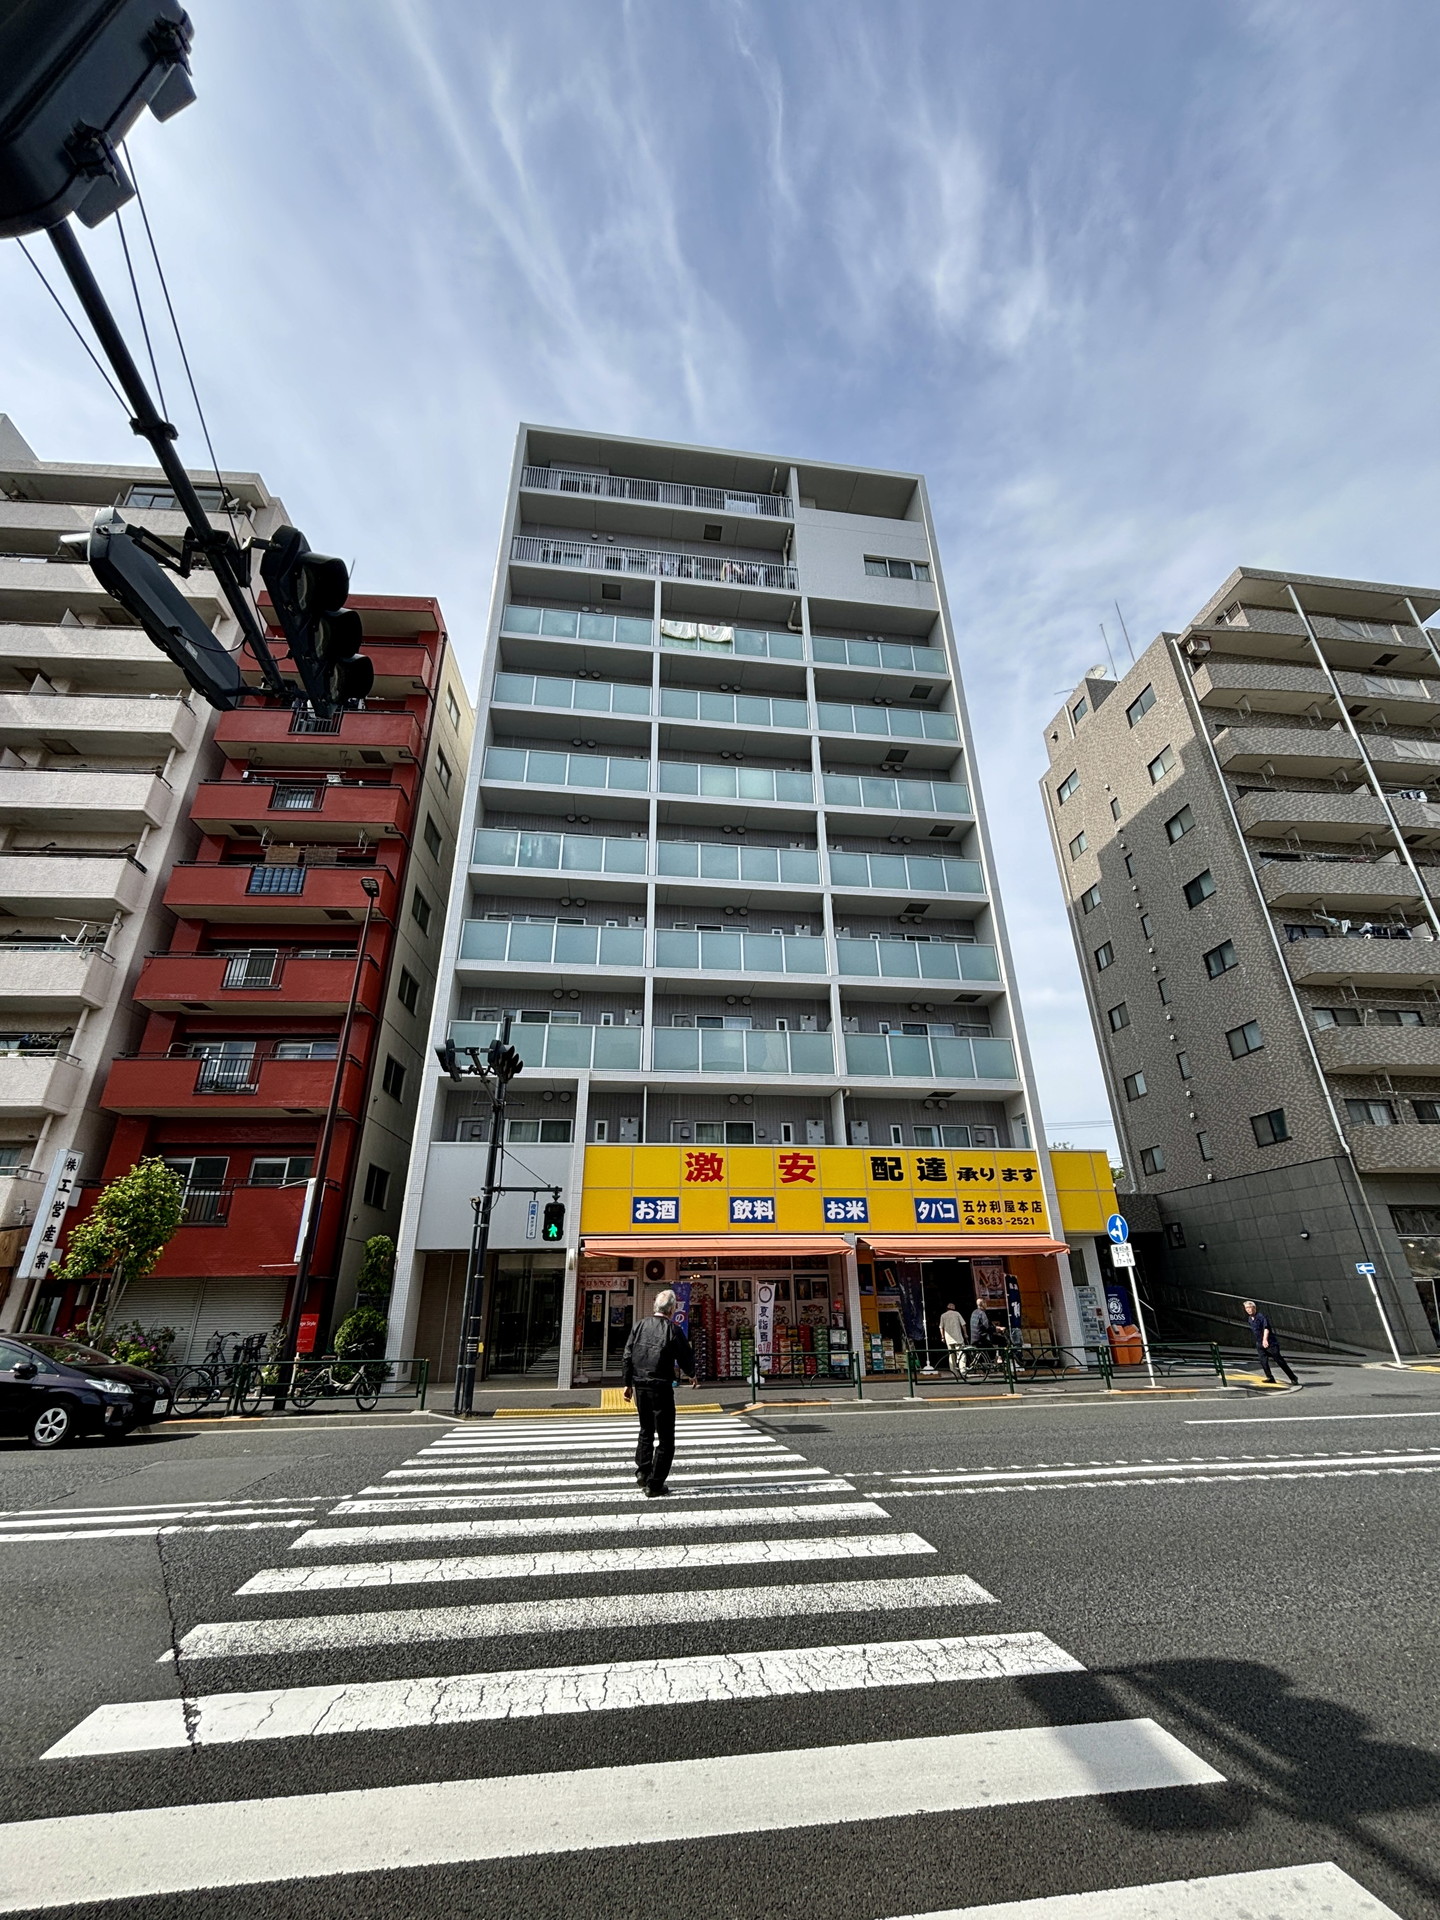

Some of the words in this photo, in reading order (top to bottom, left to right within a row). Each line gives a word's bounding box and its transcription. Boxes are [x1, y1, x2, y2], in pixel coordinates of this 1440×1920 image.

[685, 1152, 816, 1183] 激安
[635, 1200, 676, 1220] お酒
[733, 1200, 774, 1220] 飲料
[827, 1201, 865, 1220] お米
[917, 1201, 955, 1220] タバコ
[963, 1200, 1042, 1213] 五分利屋本店
[977, 1216, 1035, 1225] 3683-2521
